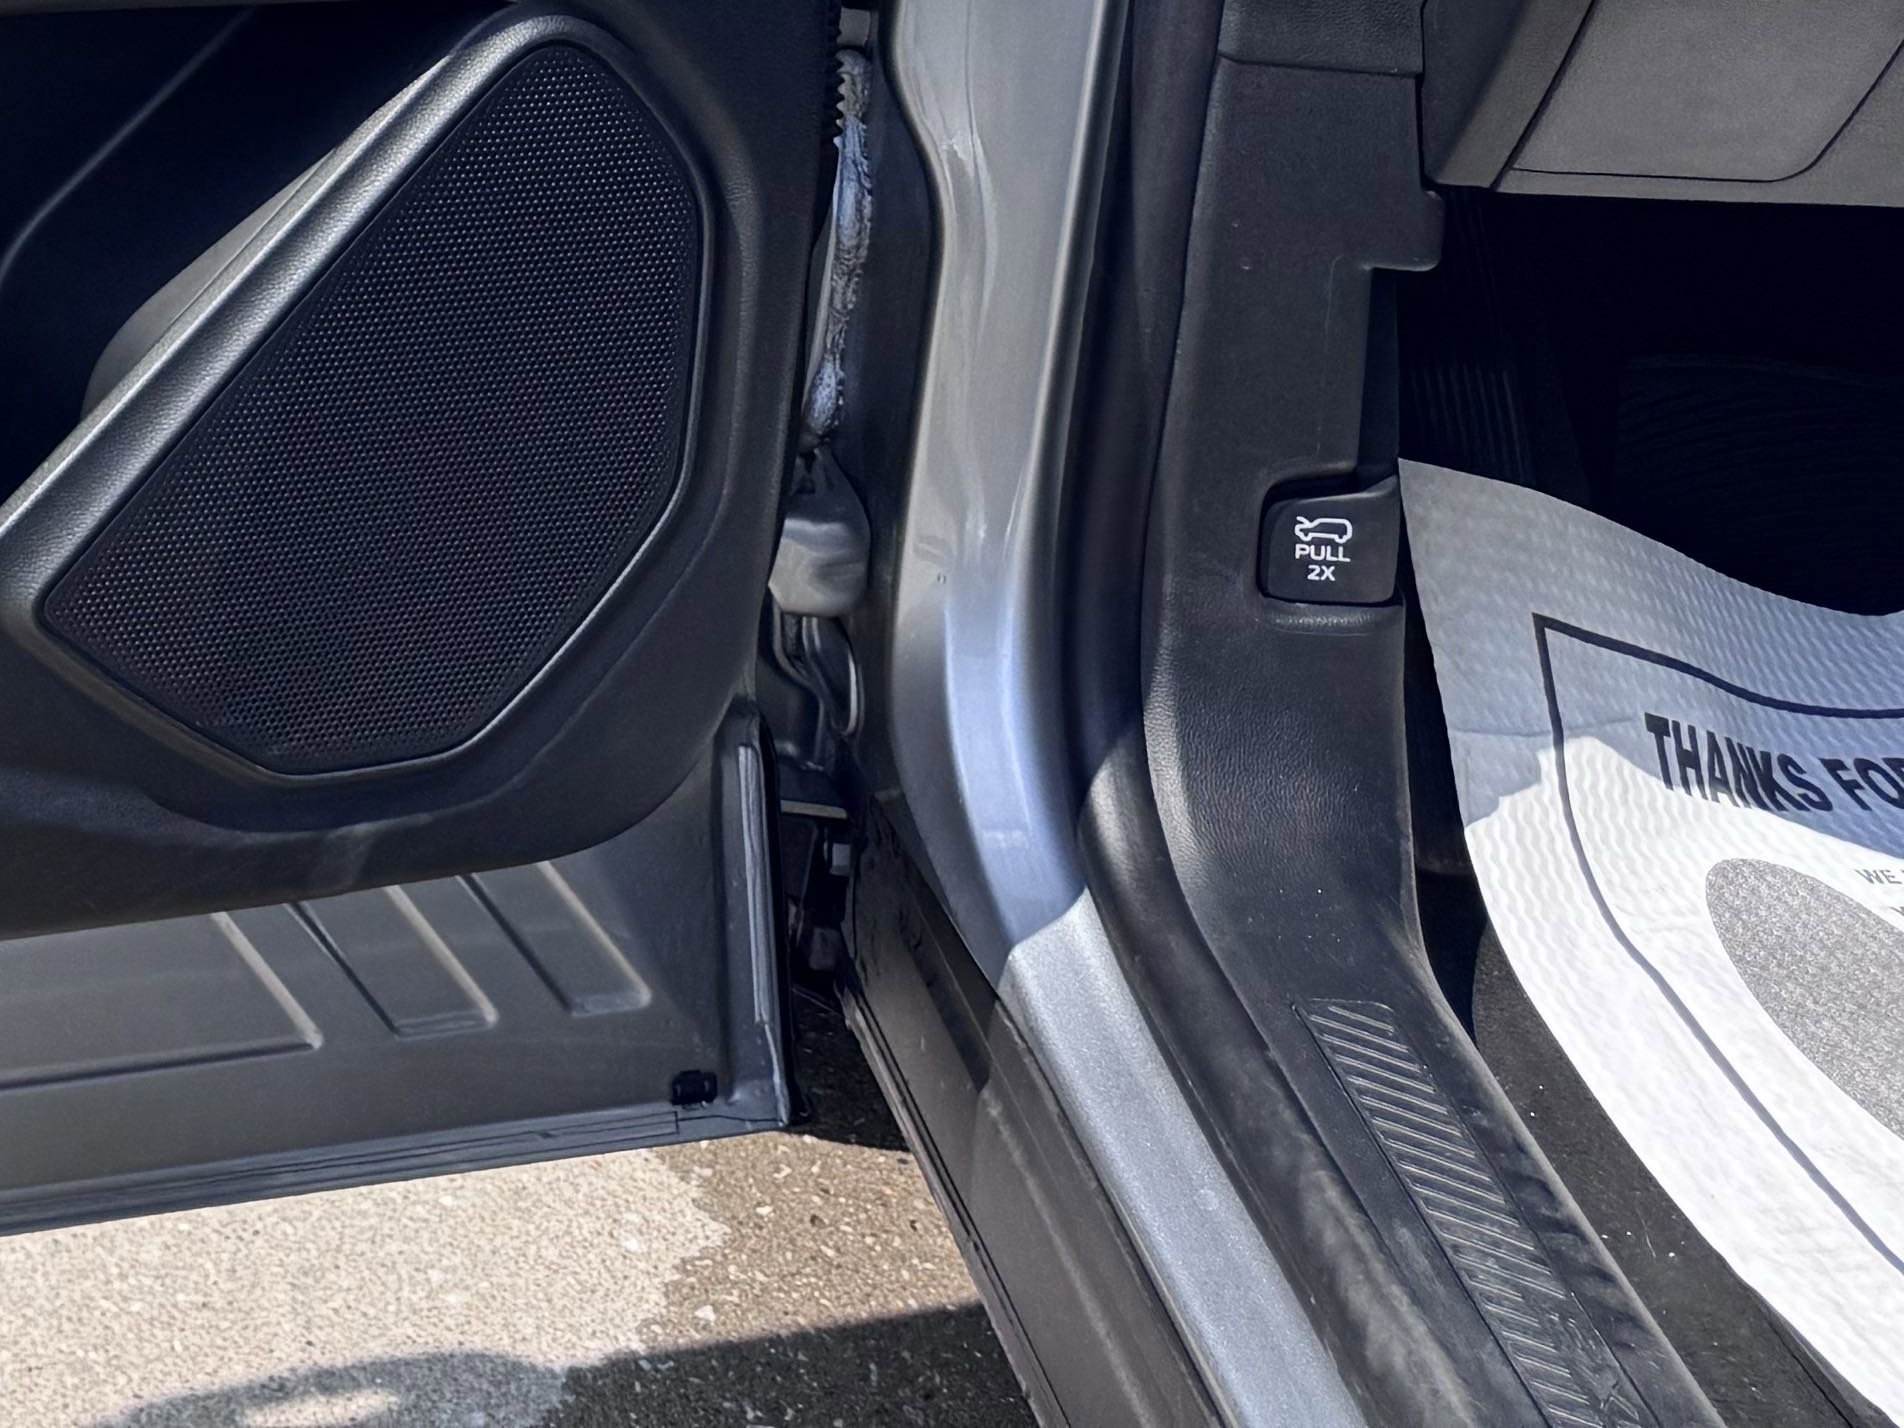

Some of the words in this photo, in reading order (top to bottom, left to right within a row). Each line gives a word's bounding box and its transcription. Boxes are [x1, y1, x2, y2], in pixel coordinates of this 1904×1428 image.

[1294, 544, 1351, 563] PULL
[1307, 564, 1336, 581] 2X
[1644, 712, 1833, 812] THANKS
